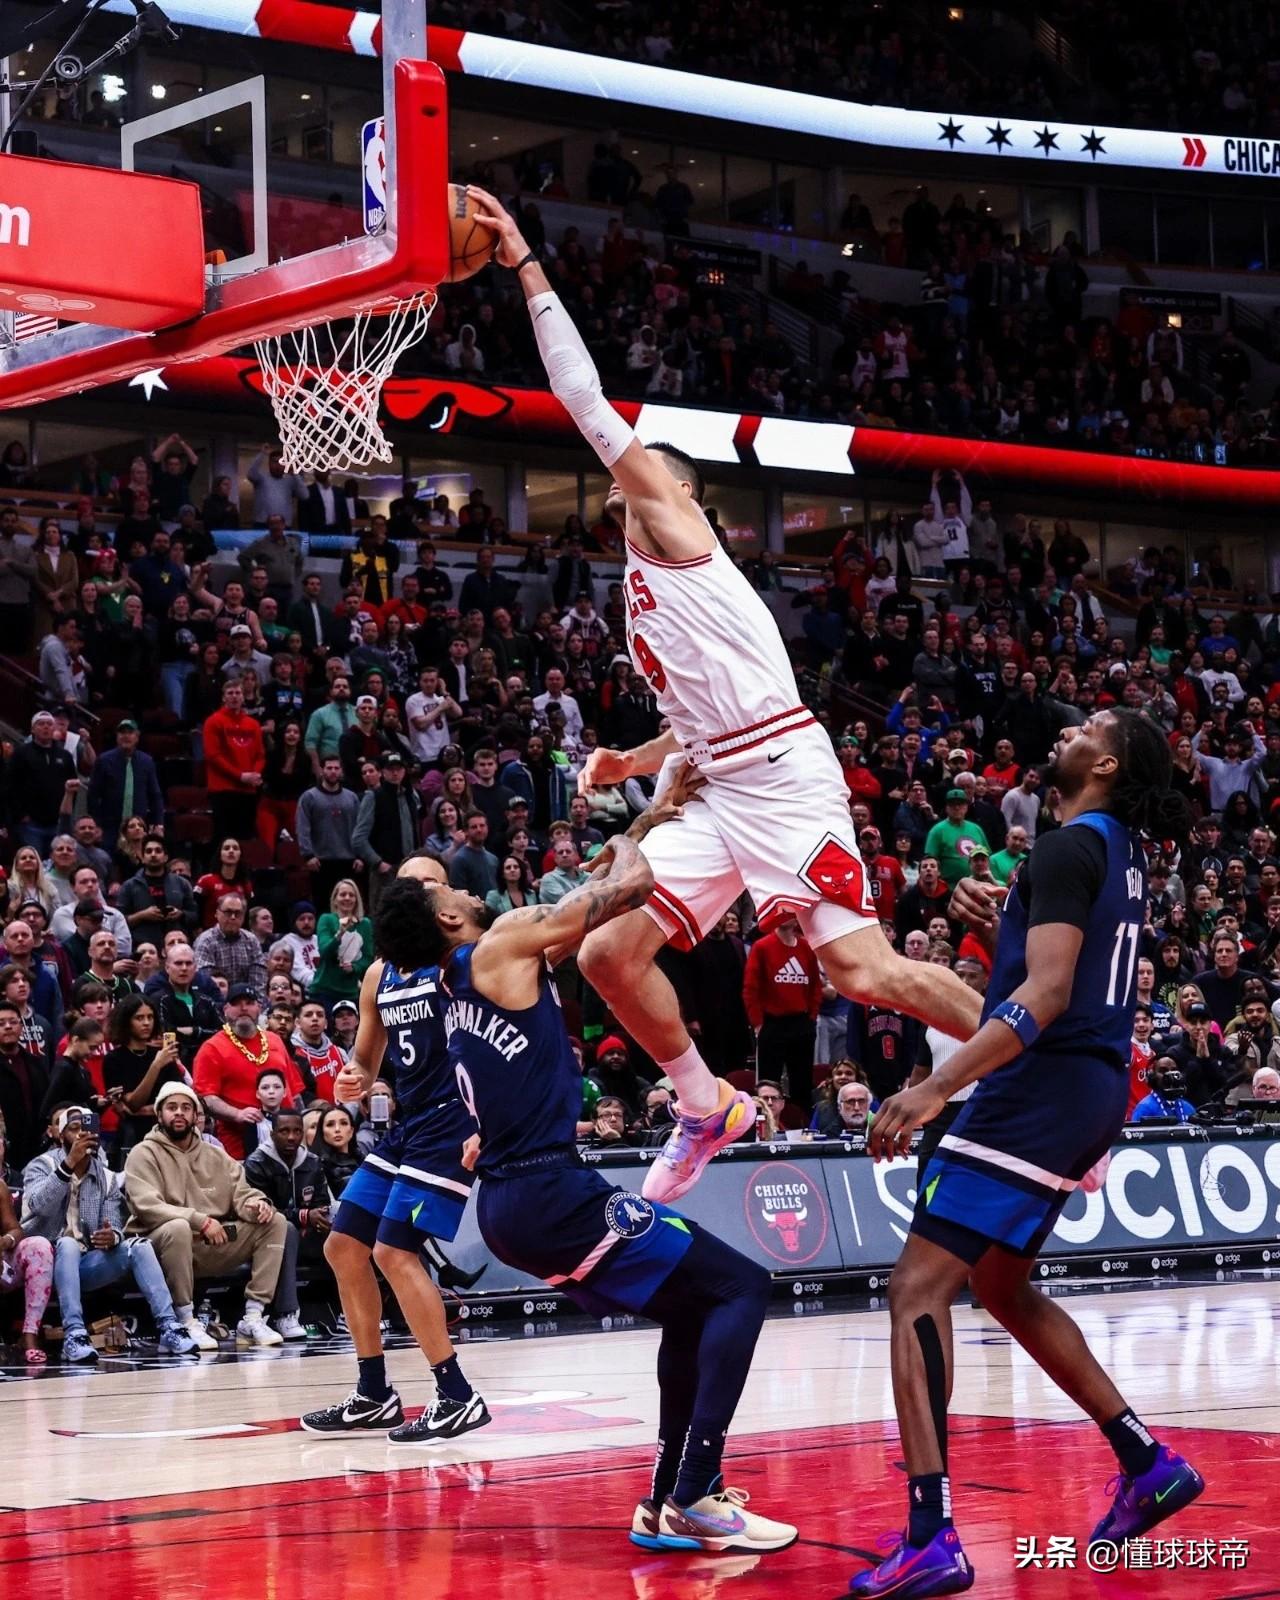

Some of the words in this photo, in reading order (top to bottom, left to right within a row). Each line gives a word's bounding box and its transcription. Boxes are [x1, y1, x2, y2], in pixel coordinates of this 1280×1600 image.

[1224, 139, 1280, 174] CHICA
[1106, 922, 1139, 1007] 11
[774, 972, 809, 985] adidas
[1010, 1004, 1025, 1021] 11
[1002, 1014, 1018, 1029] NR
[398, 1029, 416, 1066] 5
[755, 1183, 808, 1197] CHICAGO
[764, 1197, 802, 1210] BULLS
[1161, 1257, 1178, 1268] edge
[1225, 1253, 1241, 1264] edge
[1050, 1264, 1068, 1275] edge
[1112, 1260, 1129, 1271] edge
[804, 1282, 824, 1294] edge
[472, 1305, 493, 1318] edge
[536, 1300, 558, 1313] edge
